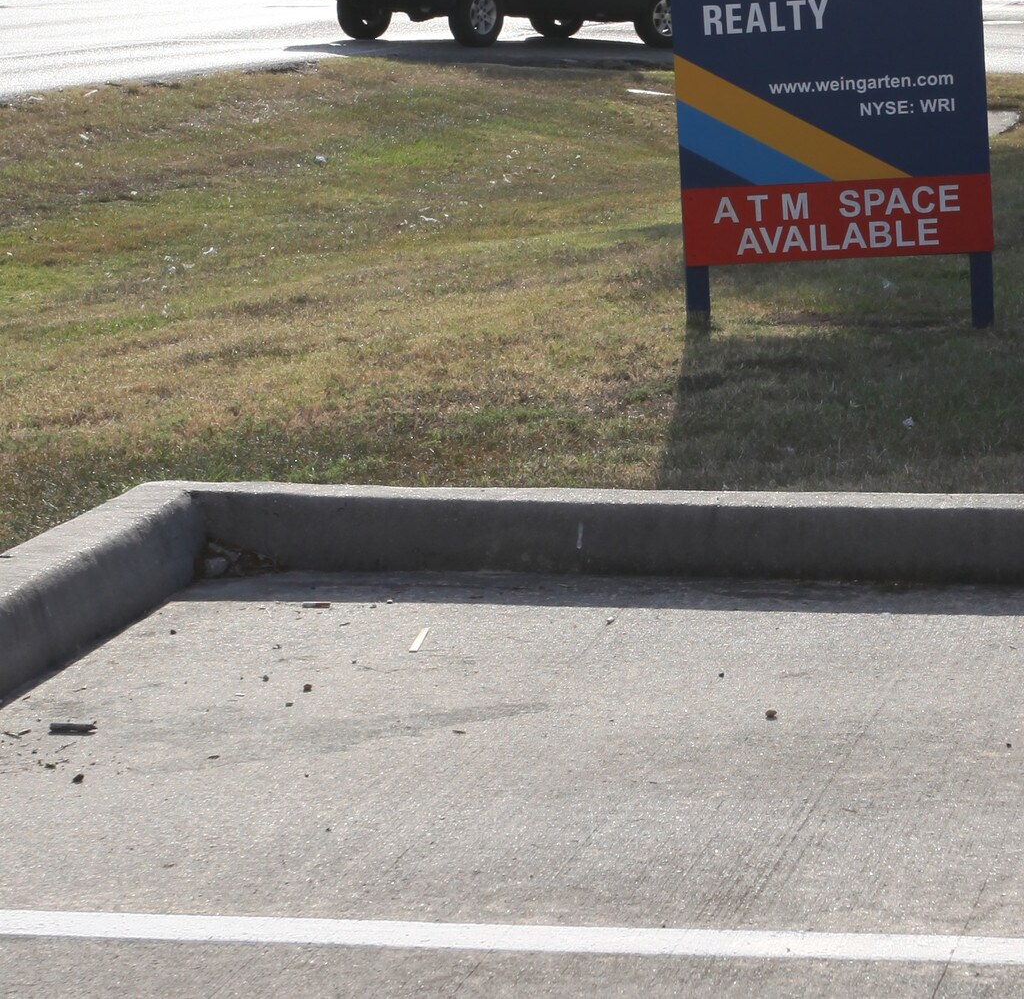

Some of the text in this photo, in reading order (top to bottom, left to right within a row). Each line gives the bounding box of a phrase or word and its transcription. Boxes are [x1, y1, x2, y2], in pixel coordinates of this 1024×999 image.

[768, 73, 955, 95] www.weingarten.com
[859, 97, 956, 117] NYSE: WRI
[839, 184, 961, 218] SPACE
[736, 217, 940, 256] AVAILABLE
